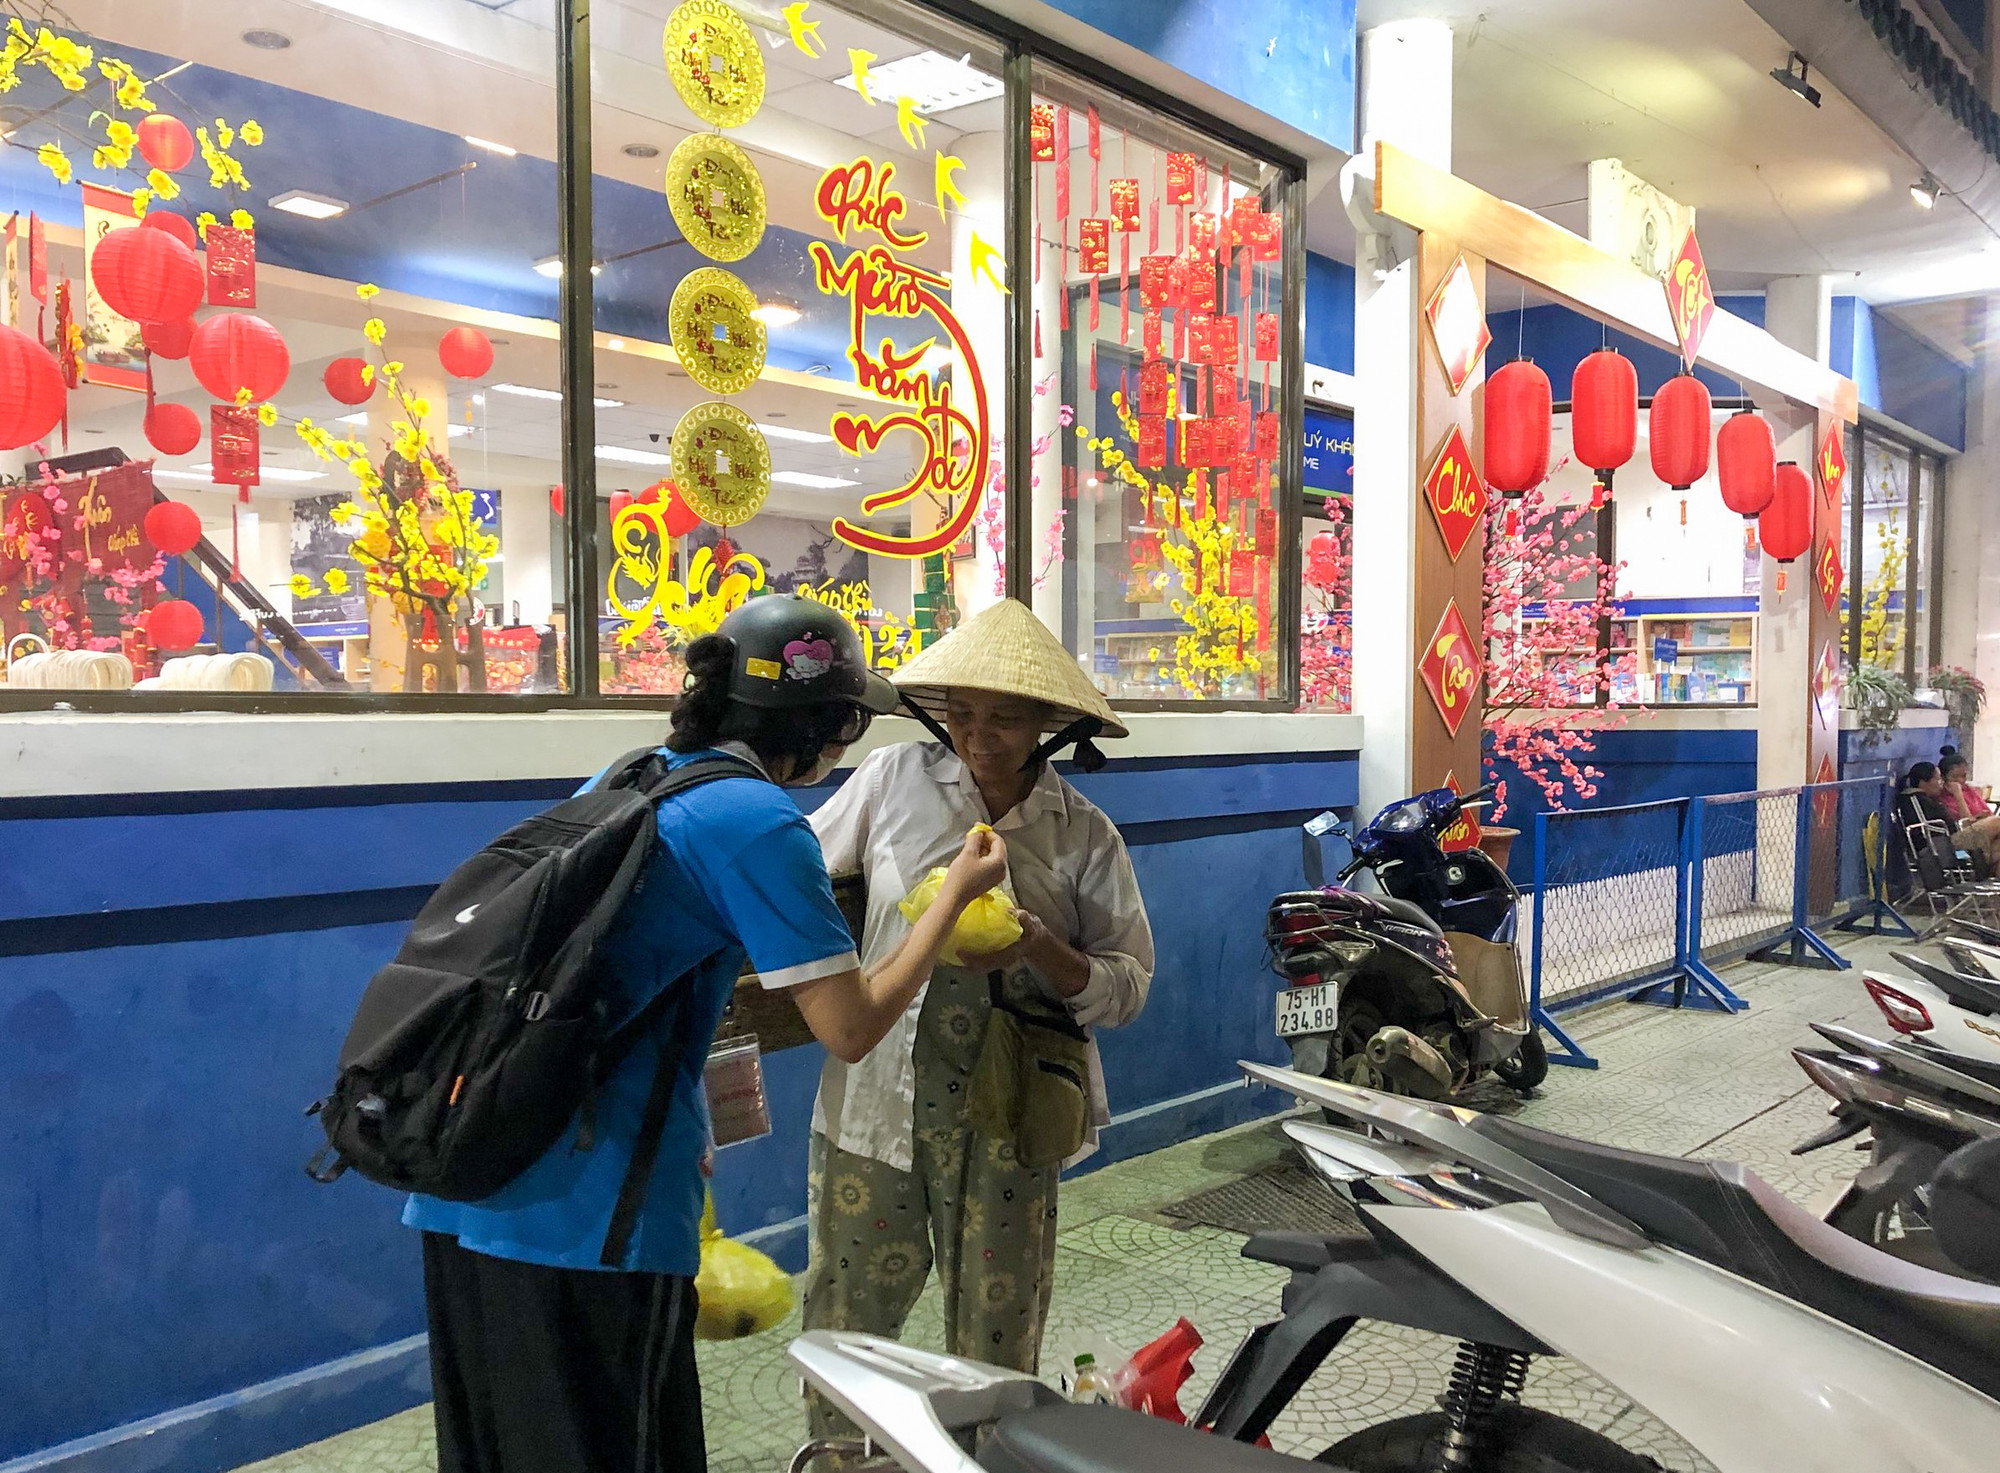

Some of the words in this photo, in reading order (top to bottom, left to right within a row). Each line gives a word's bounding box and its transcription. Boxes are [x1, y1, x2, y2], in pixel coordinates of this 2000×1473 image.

[1303, 430, 1323, 449] UÝ
[1326, 437, 1354, 456] KHÁ
[1436, 457, 1478, 518] Chúc
[1280, 1007, 1333, 1033] 234.88
